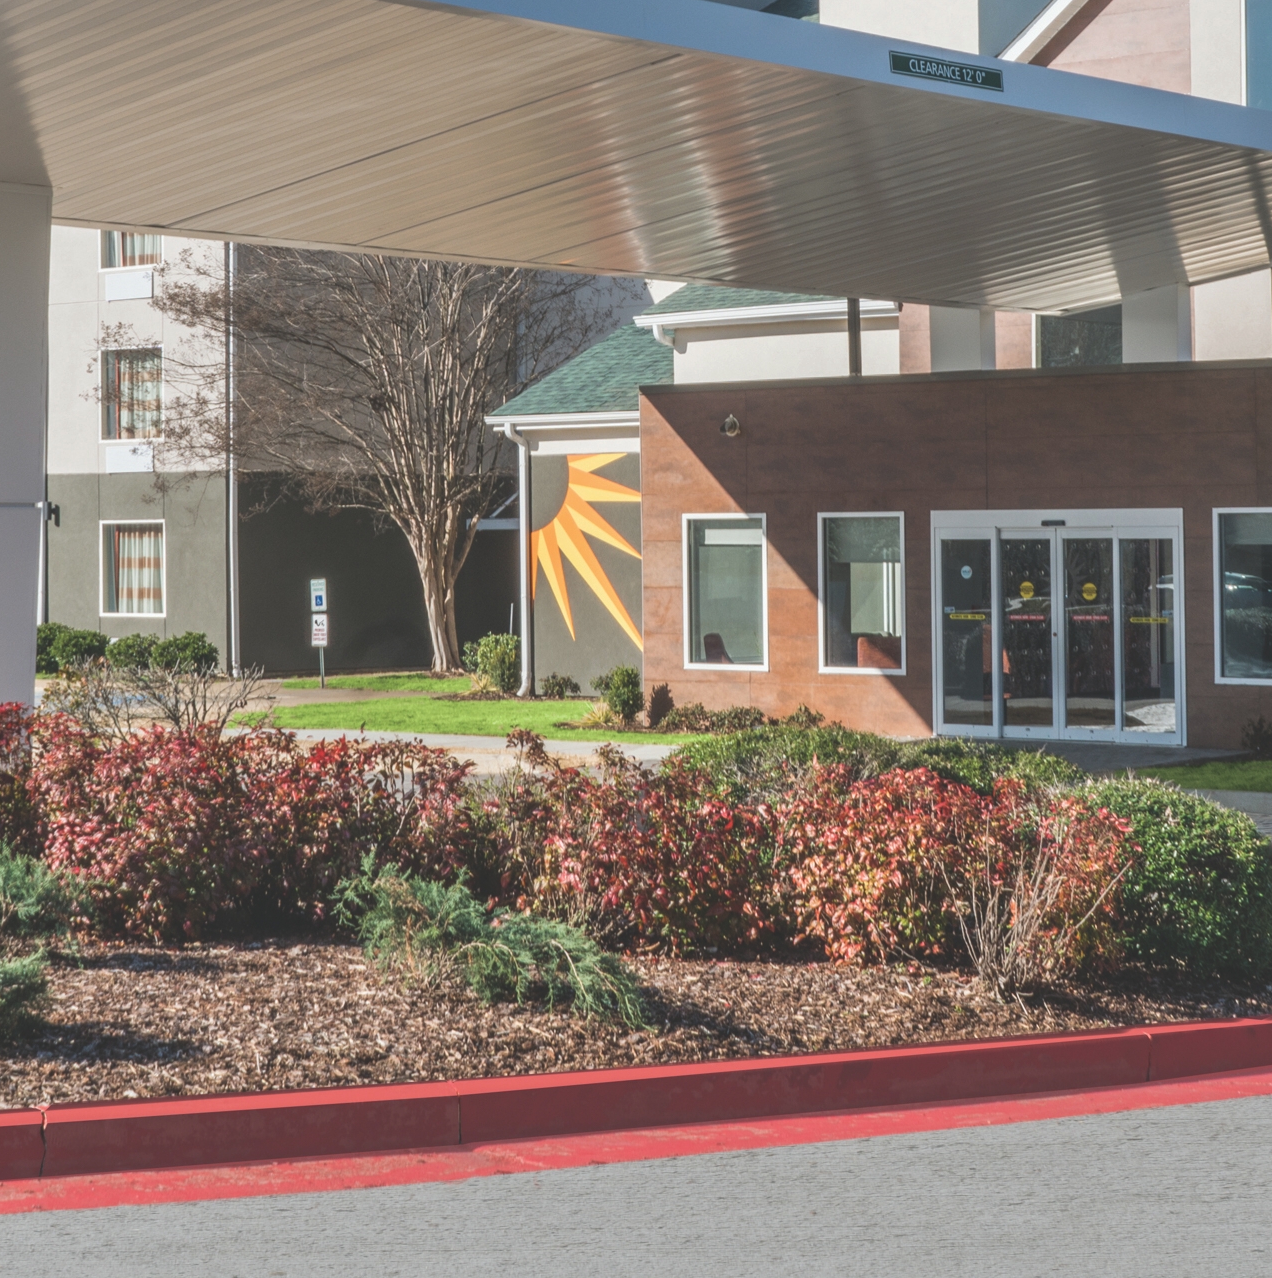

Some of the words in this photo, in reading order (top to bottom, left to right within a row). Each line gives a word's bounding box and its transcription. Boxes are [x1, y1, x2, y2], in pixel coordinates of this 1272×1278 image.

[909, 59, 961, 80] CLEARANCE
[963, 69, 974, 82] 12'
[975, 70, 986, 83] 0"
